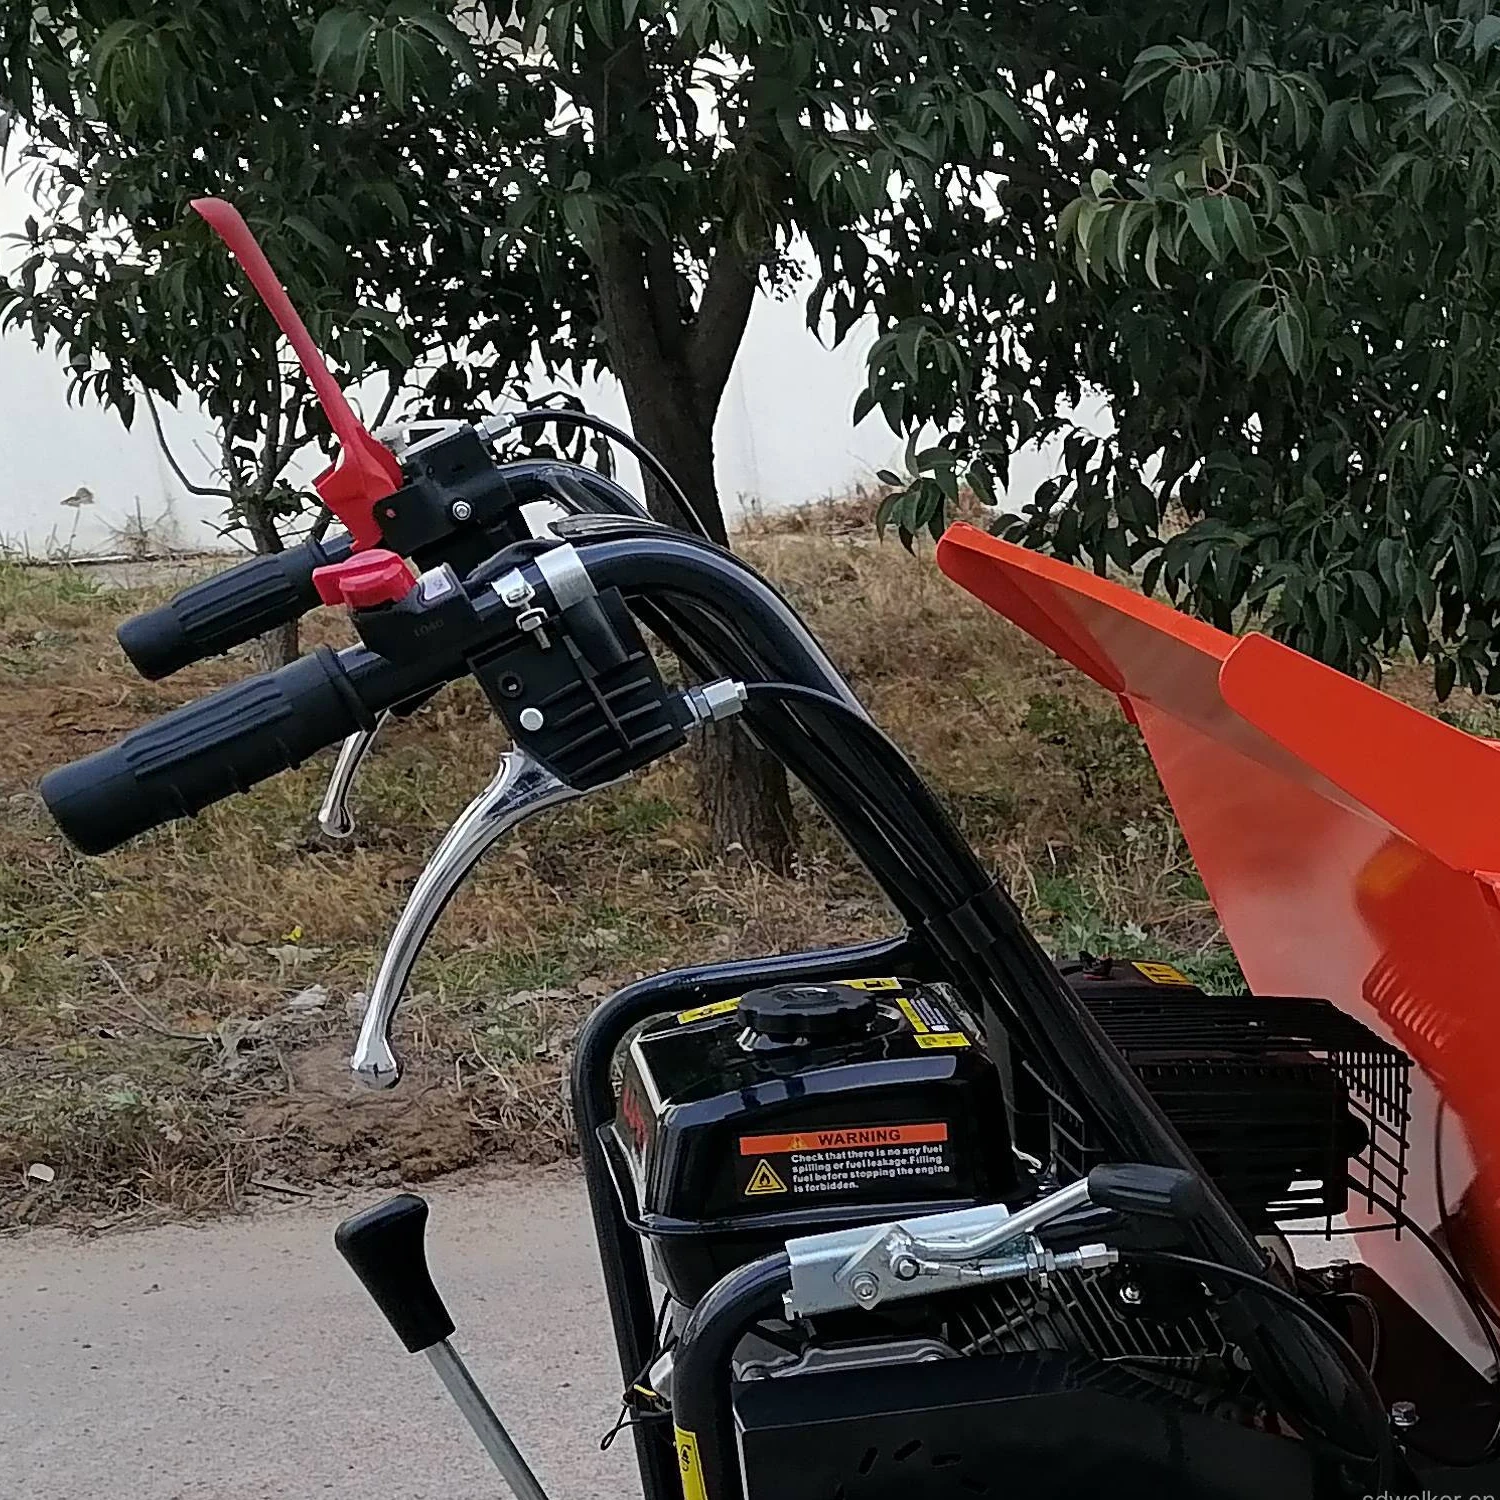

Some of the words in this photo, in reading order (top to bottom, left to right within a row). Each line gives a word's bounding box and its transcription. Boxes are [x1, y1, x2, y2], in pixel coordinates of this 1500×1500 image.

[818, 1129, 901, 1146] WARNING
[791, 1153, 824, 1163] Check
[825, 1151, 846, 1161] that
[847, 1150, 875, 1159] there
[876, 1148, 886, 1157] is
[888, 1148, 901, 1156] no
[902, 1147, 921, 1156] any
[922, 1144, 943, 1154] fuel
[792, 1163, 832, 1174] spilling
[833, 1162, 845, 1170] or
[845, 1159, 866, 1169] fuel
[792, 1173, 814, 1183] fuel
[814, 1172, 848, 1181] before
[850, 1167, 896, 1179] stopping
[896, 1167, 914, 1176] the
[914, 1164, 950, 1175] engine
[793, 1184, 804, 1193] is
